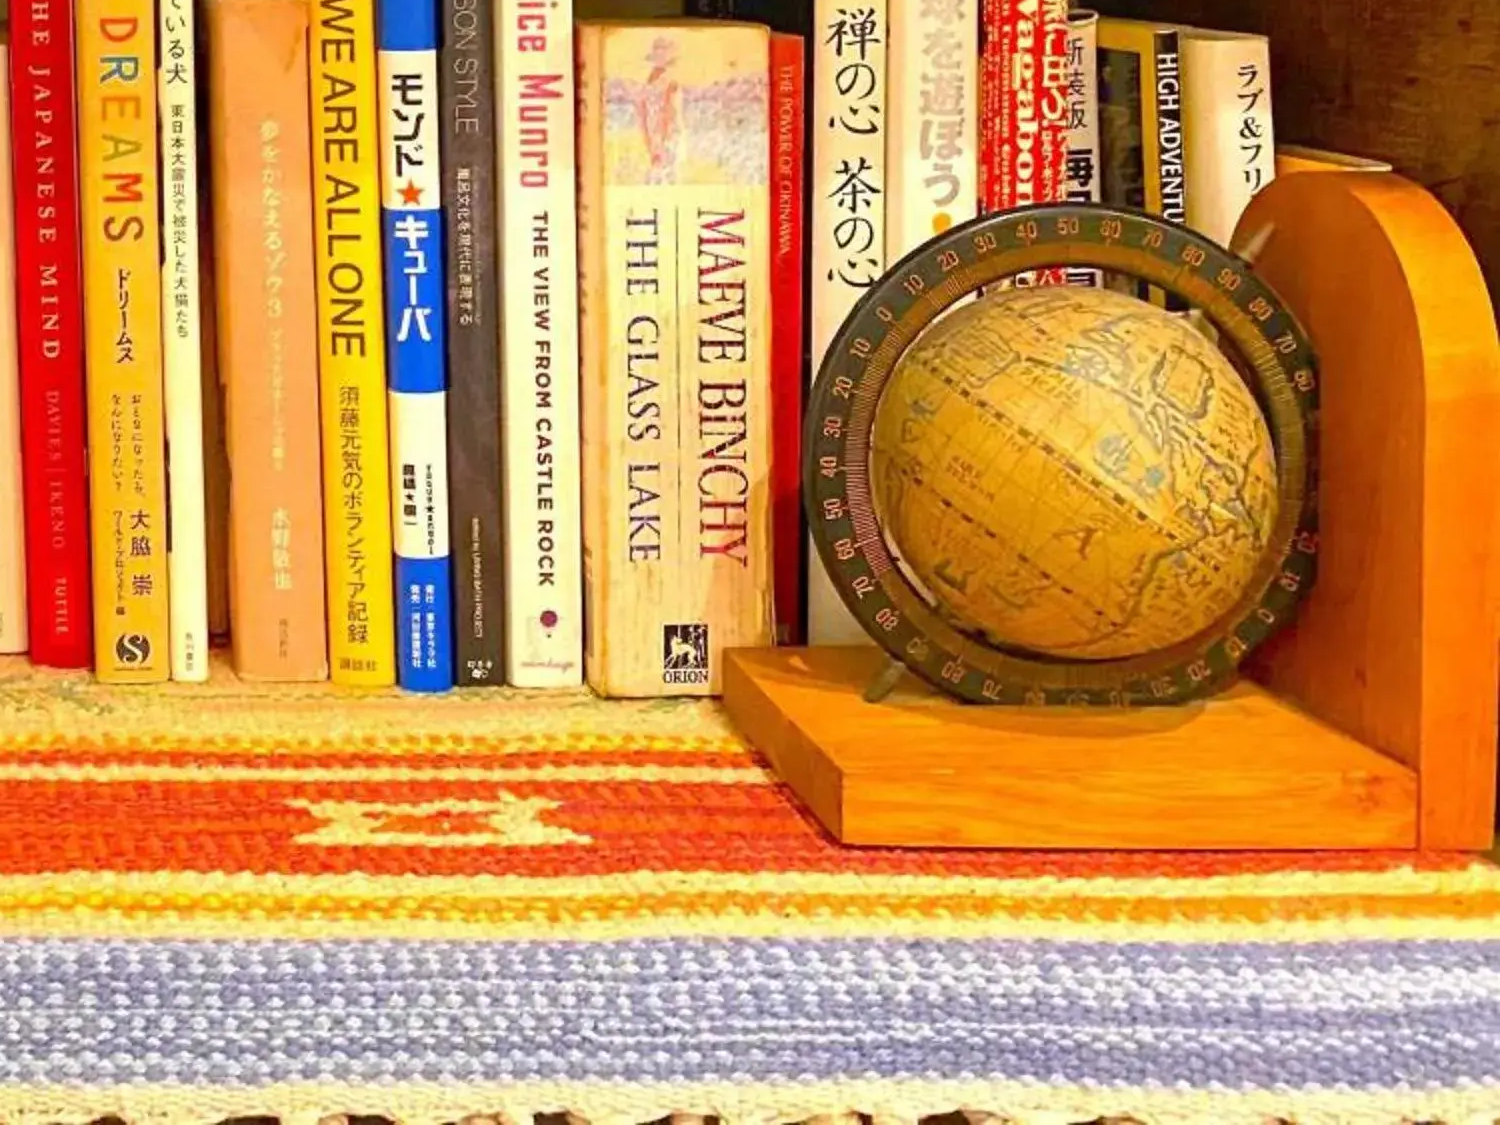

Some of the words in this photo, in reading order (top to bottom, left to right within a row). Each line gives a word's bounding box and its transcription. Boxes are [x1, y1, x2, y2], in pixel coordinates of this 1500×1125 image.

[453, 57, 481, 137] STYLE
[781, 64, 796, 93] THE
[826, 5, 882, 136] 禅の心
[1155, 53, 1179, 111] HIGH
[29, 64, 58, 244] JAPANESE
[98, 16, 145, 243] DREAMS
[322, 72, 359, 164] ARE
[391, 73, 426, 178] モンド
[518, 73, 565, 190] Munro
[778, 96, 794, 153] POWER
[778, 155, 793, 171] OF
[325, 174, 362, 257] ALL
[532, 210, 550, 260] THE
[625, 207, 659, 296] THE
[777, 173, 795, 257] OKINAWA
[826, 156, 882, 289] 茶の心
[1057, 218, 1080, 236] 50
[395, 213, 433, 343] キューバ
[532, 266, 552, 332] VIEW
[696, 207, 748, 365] MAEVE
[904, 274, 926, 298] 10
[937, 250, 960, 272] 20
[38, 263, 61, 358] MIND
[115, 266, 135, 364] ドリームス
[328, 261, 367, 357] ONE
[534, 338, 552, 410] FROM
[626, 313, 661, 443] GLASS
[849, 337, 872, 359] 10
[833, 376, 855, 399] 20
[45, 390, 63, 462] DAVIES
[823, 415, 844, 441] 30
[535, 417, 555, 512] CASTLE
[697, 378, 750, 567] BINCHY
[819, 456, 840, 478] 40
[49, 481, 67, 550] IKENO
[338, 385, 370, 644] 須藤元気のボランティア記録
[627, 461, 662, 563] LAKE
[824, 497, 844, 522] 50
[536, 518, 555, 588] ROCK
[852, 576, 876, 599] 70
[56, 576, 69, 635] TUTTLE
[662, 669, 709, 684] ORION
